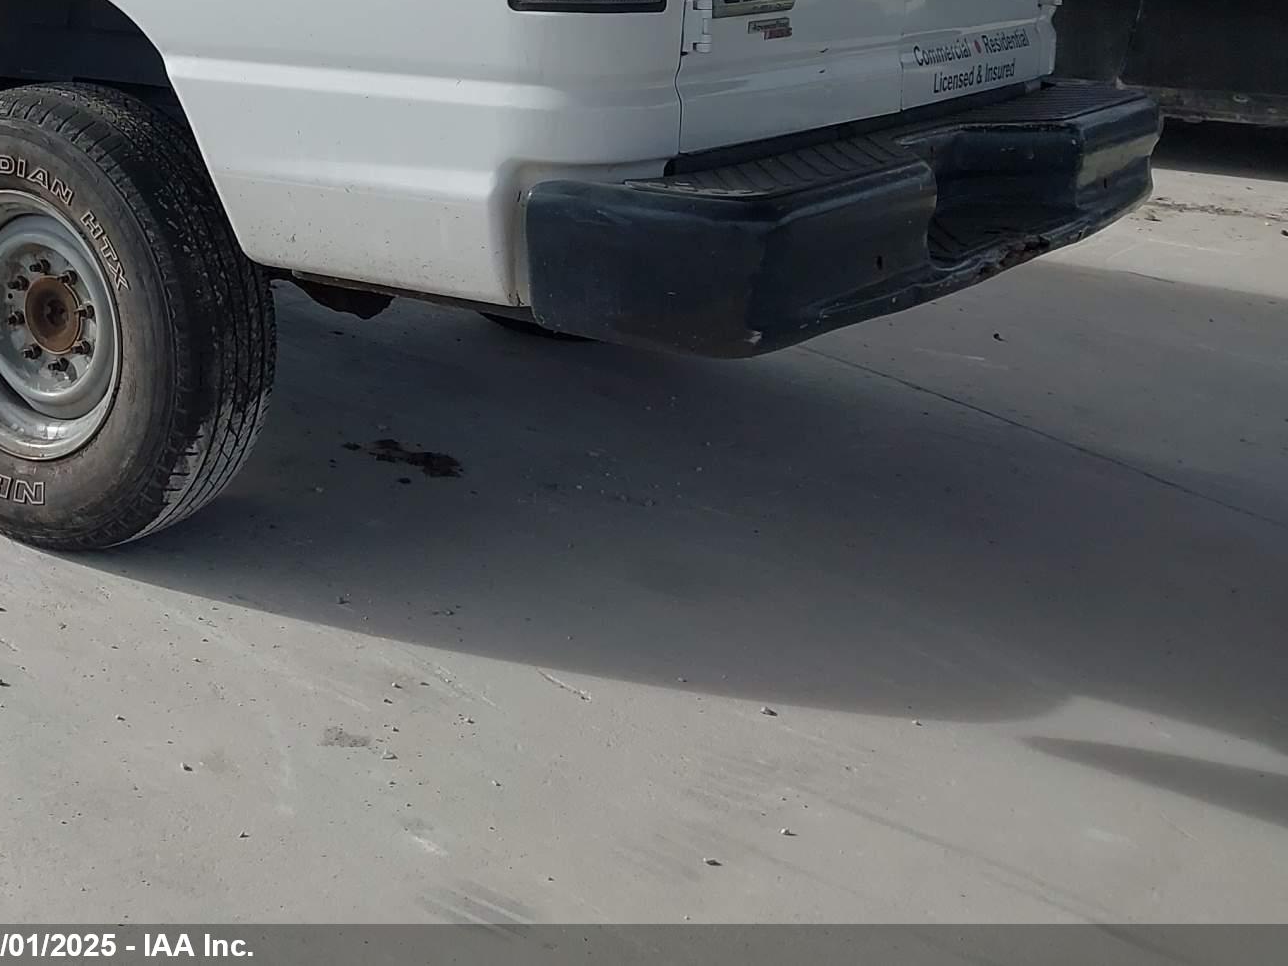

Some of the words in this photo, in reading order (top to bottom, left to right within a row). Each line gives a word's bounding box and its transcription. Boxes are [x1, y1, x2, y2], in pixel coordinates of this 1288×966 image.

[913, 37, 972, 67] Commercial
[981, 28, 1031, 54] Residential
[933, 65, 974, 94] Licensed
[975, 65, 983, 85] &
[985, 58, 1016, 83] Insured
[79, 210, 131, 292] HTX
